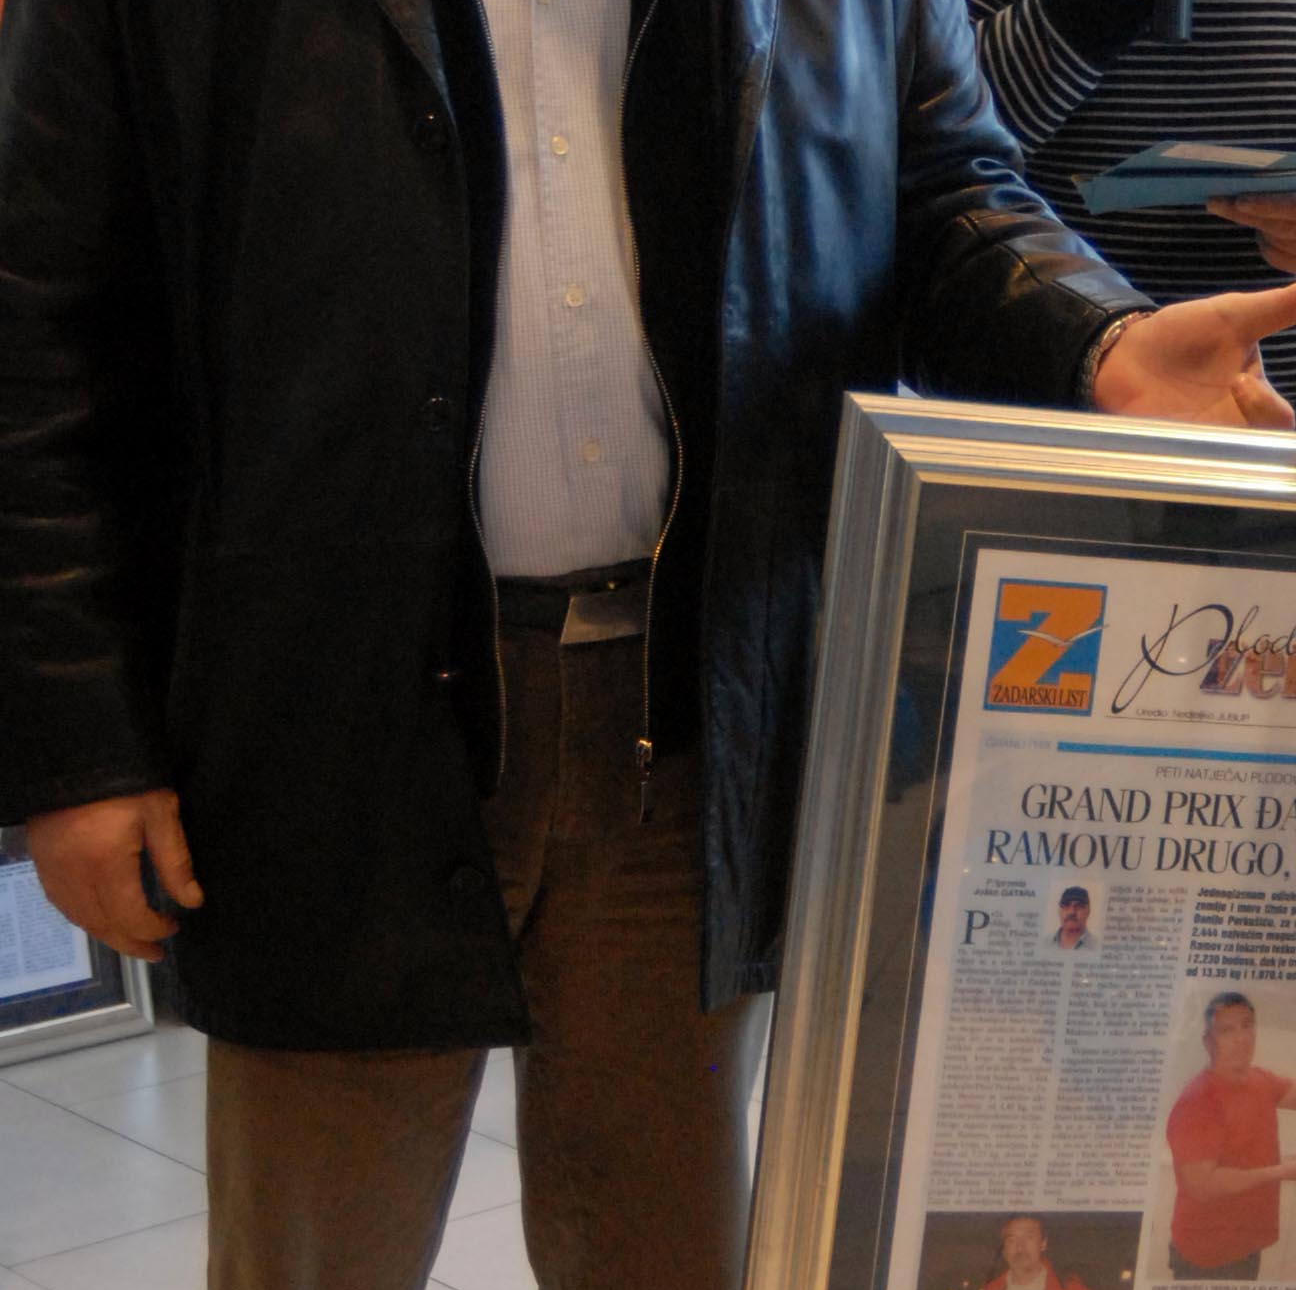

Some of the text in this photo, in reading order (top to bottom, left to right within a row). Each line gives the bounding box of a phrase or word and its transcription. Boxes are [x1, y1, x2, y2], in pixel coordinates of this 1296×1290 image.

[993, 684, 1088, 709] ZADARSKI LIST
[1155, 765, 1182, 778] PETI
[1185, 767, 1248, 783] NATJEČAJ
[1020, 783, 1151, 824] GRAND
[1162, 790, 1247, 830] PRIX
[984, 829, 1146, 871] RAMOVU
[1154, 836, 1291, 881] DRUGO,
